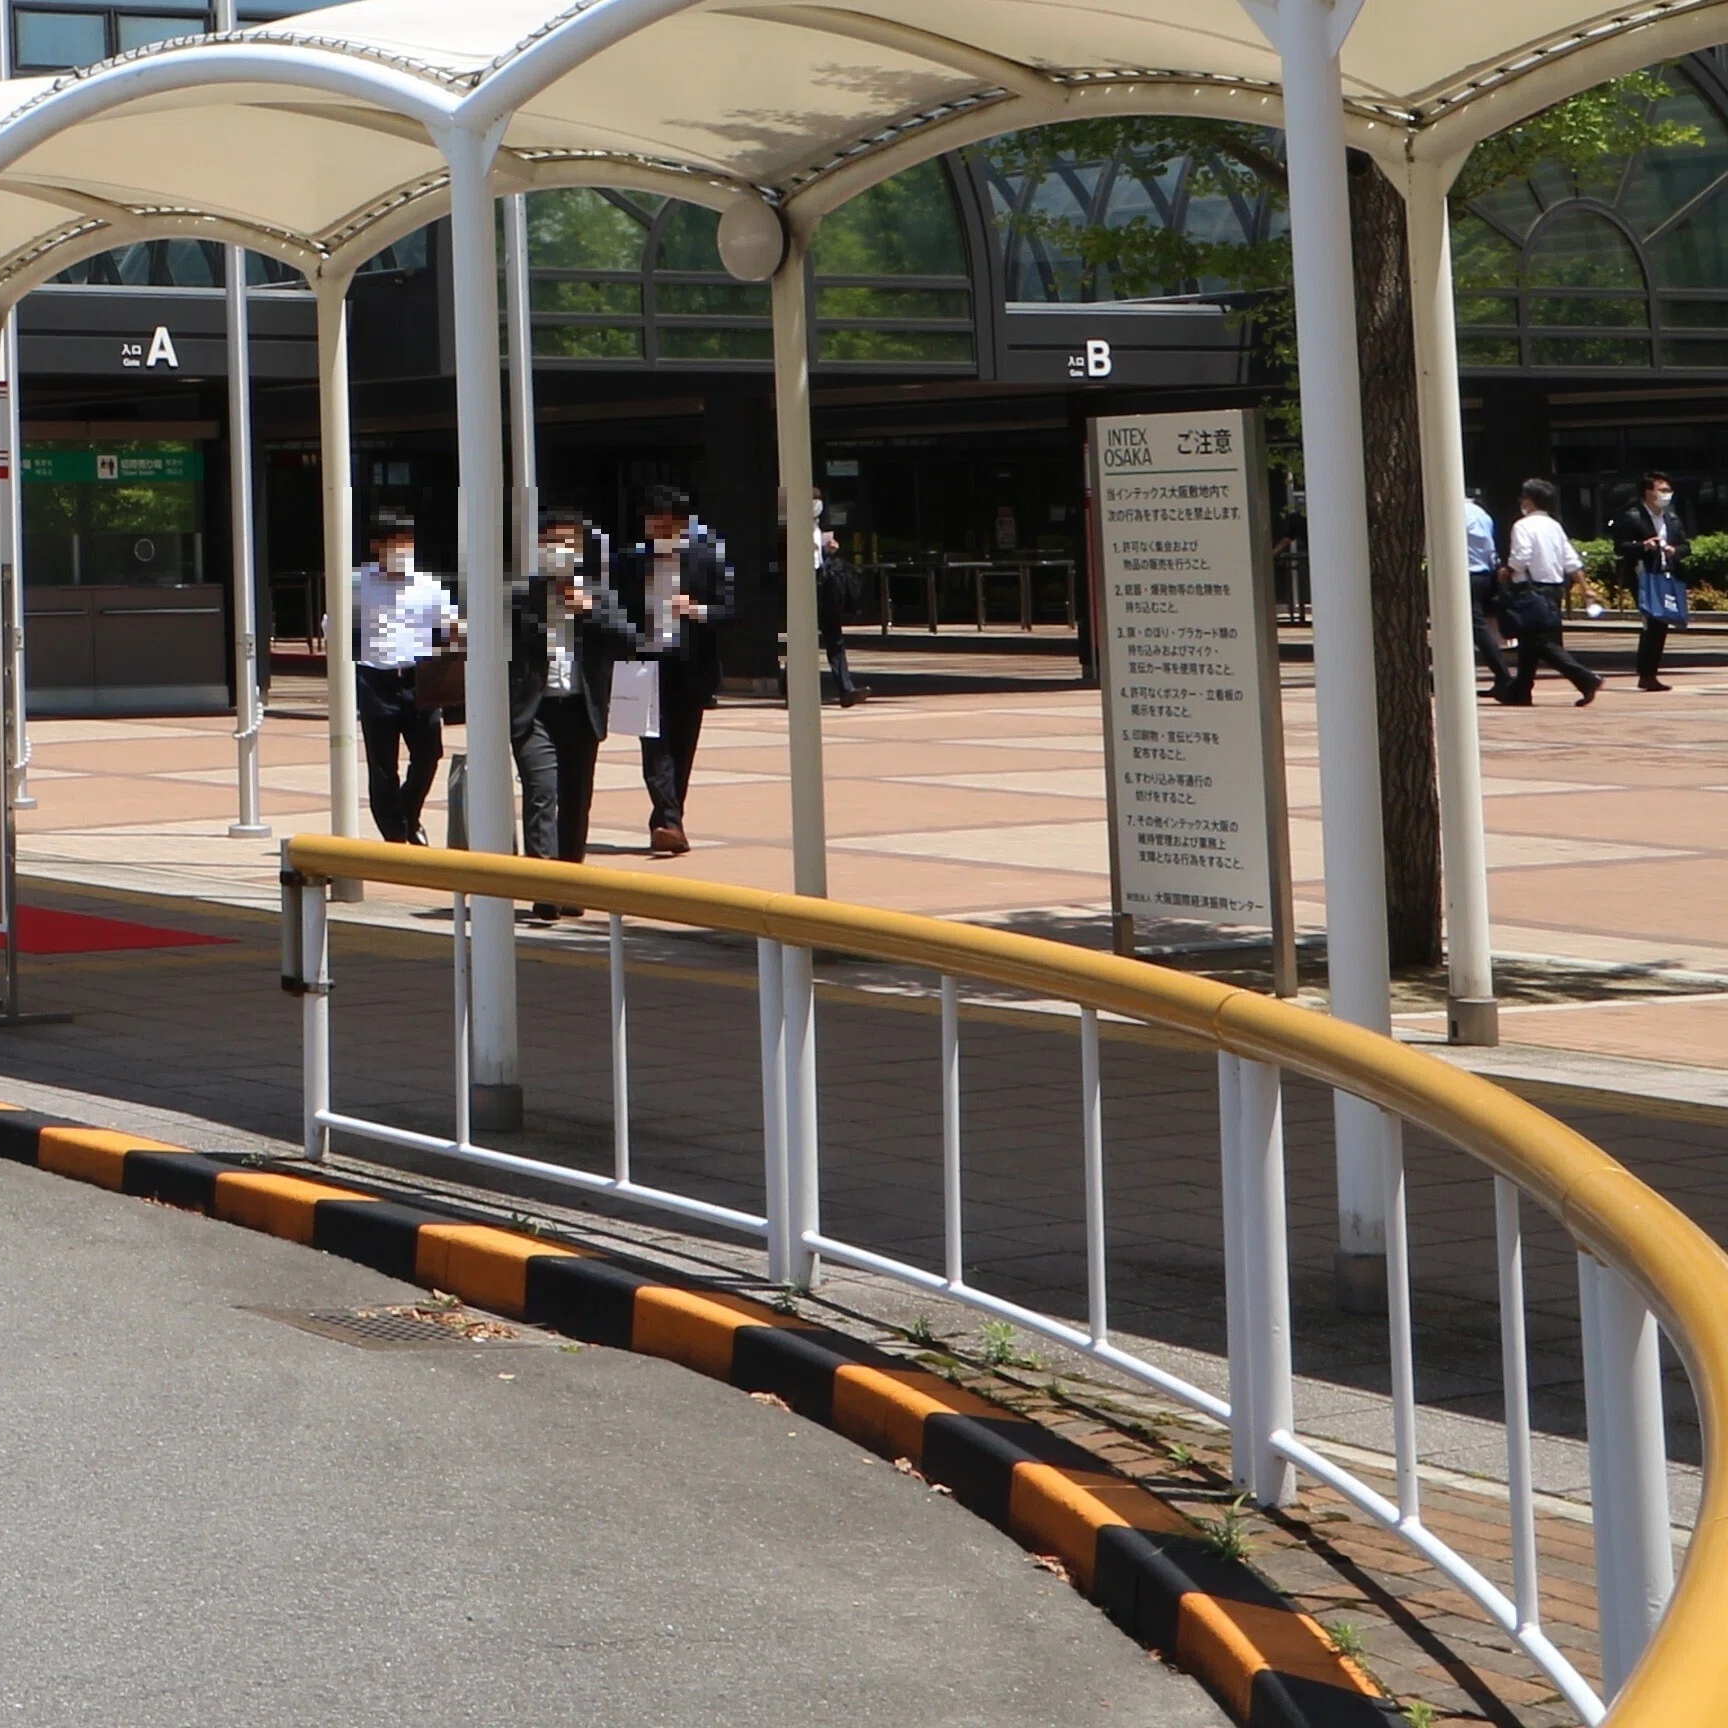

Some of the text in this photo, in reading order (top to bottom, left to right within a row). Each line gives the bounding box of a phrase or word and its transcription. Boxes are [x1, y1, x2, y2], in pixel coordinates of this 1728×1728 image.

[121, 326, 179, 368] 入口 A
[1067, 339, 1112, 377] 入口 B
[1108, 428, 1148, 446] INTEX
[1177, 429, 1233, 455] ご注意
[1104, 448, 1153, 467] OSAKA
